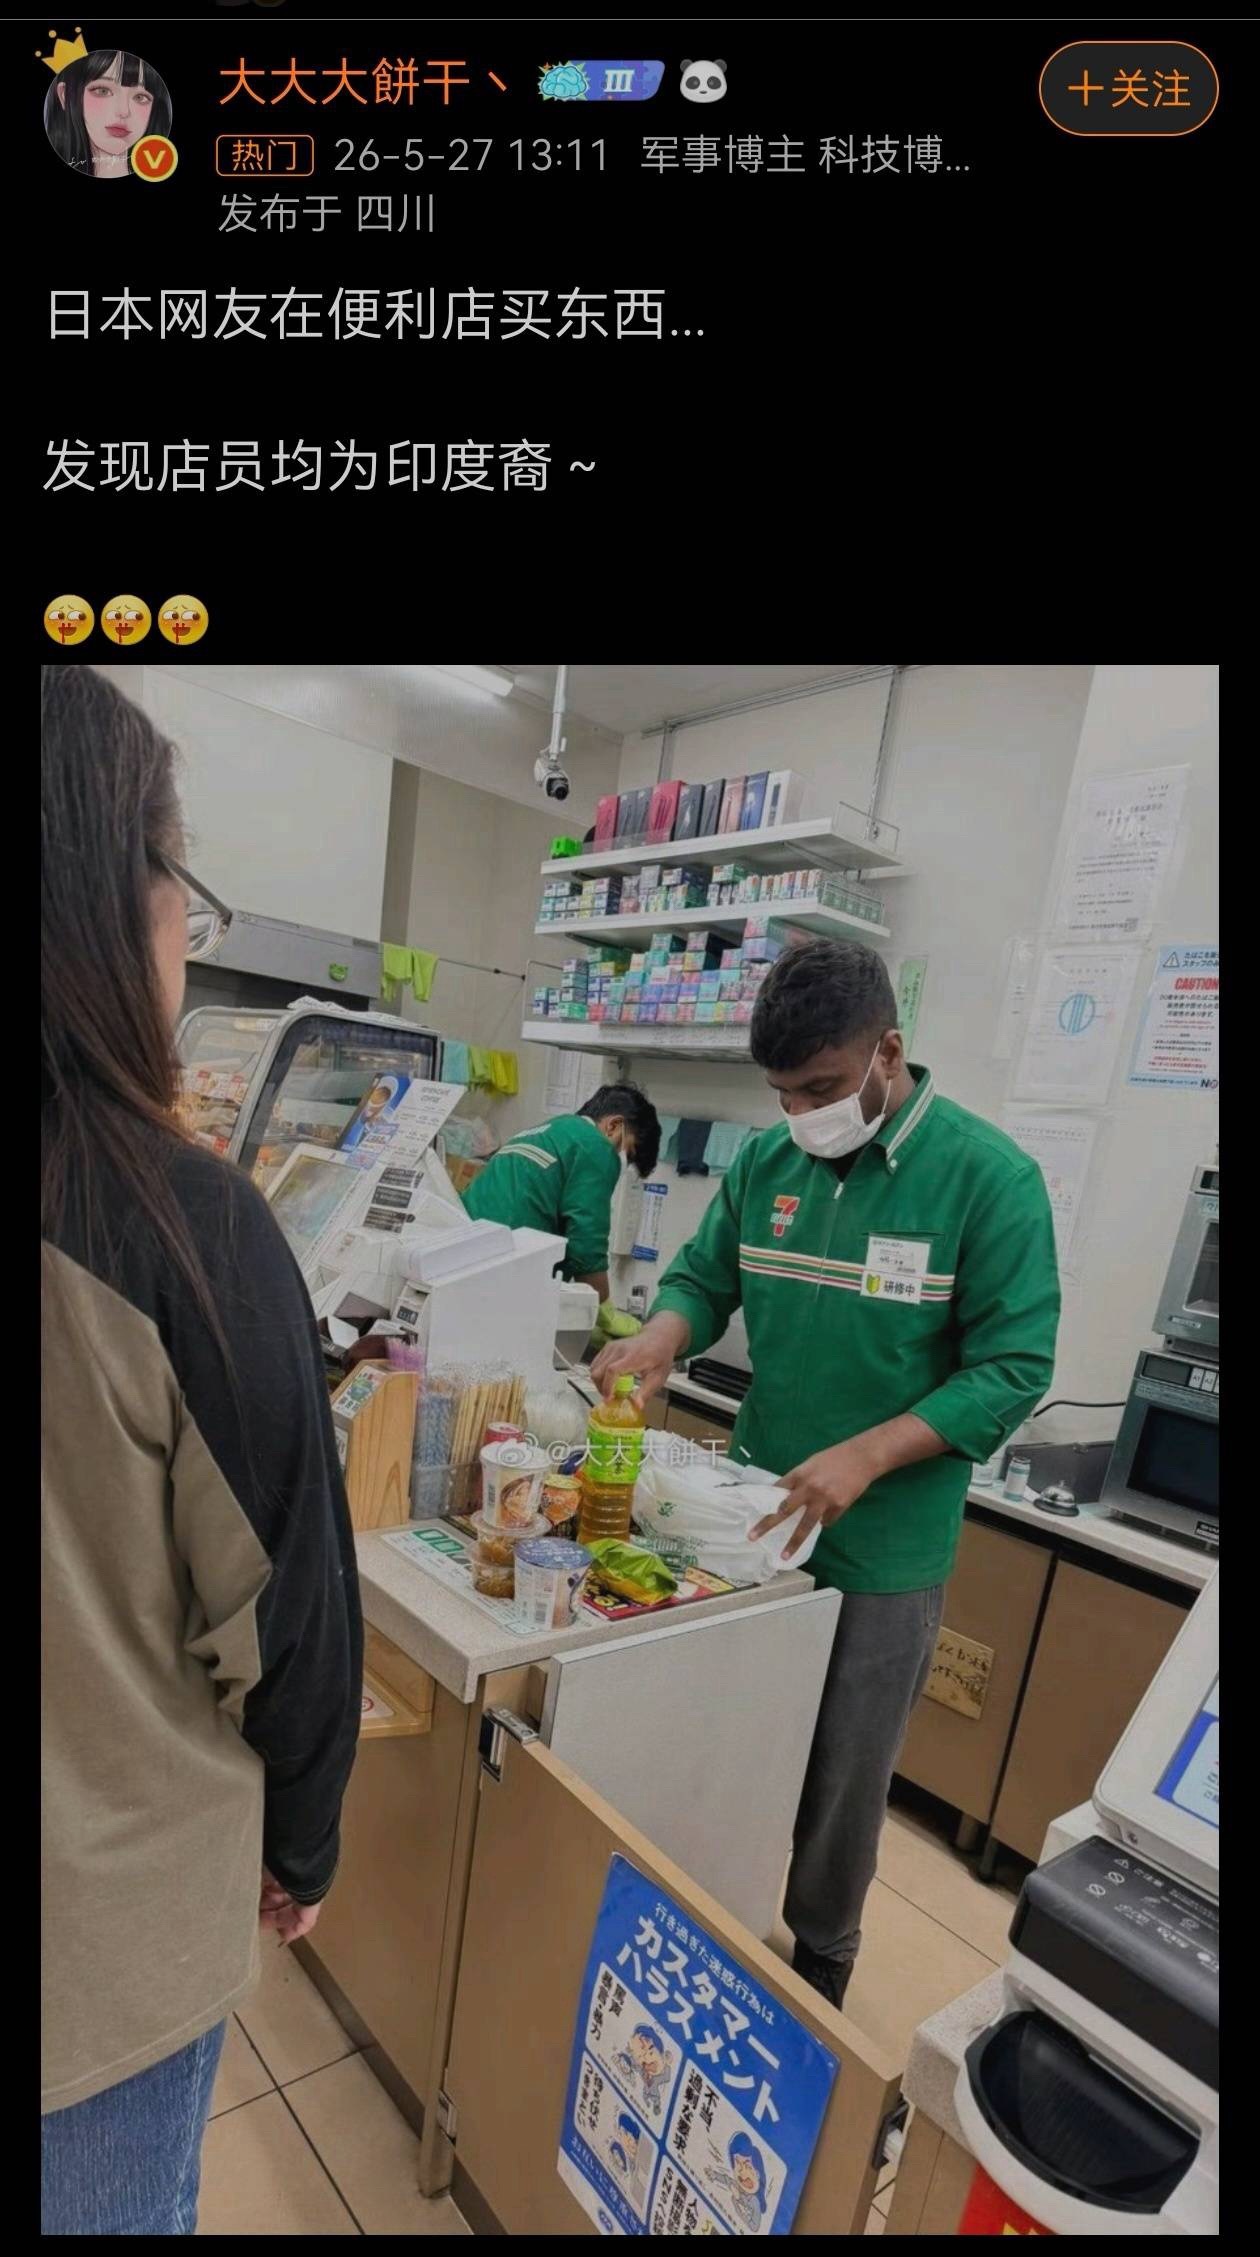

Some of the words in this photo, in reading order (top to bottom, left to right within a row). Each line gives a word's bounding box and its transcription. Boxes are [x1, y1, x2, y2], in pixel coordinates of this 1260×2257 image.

[884, 1279, 915, 1297] 研修中
[616, 1943, 780, 2123] ハラスメント
[634, 1914, 780, 2070] カスタマー
[655, 1902, 774, 2026] 行き過ぎた迷惑行為は
